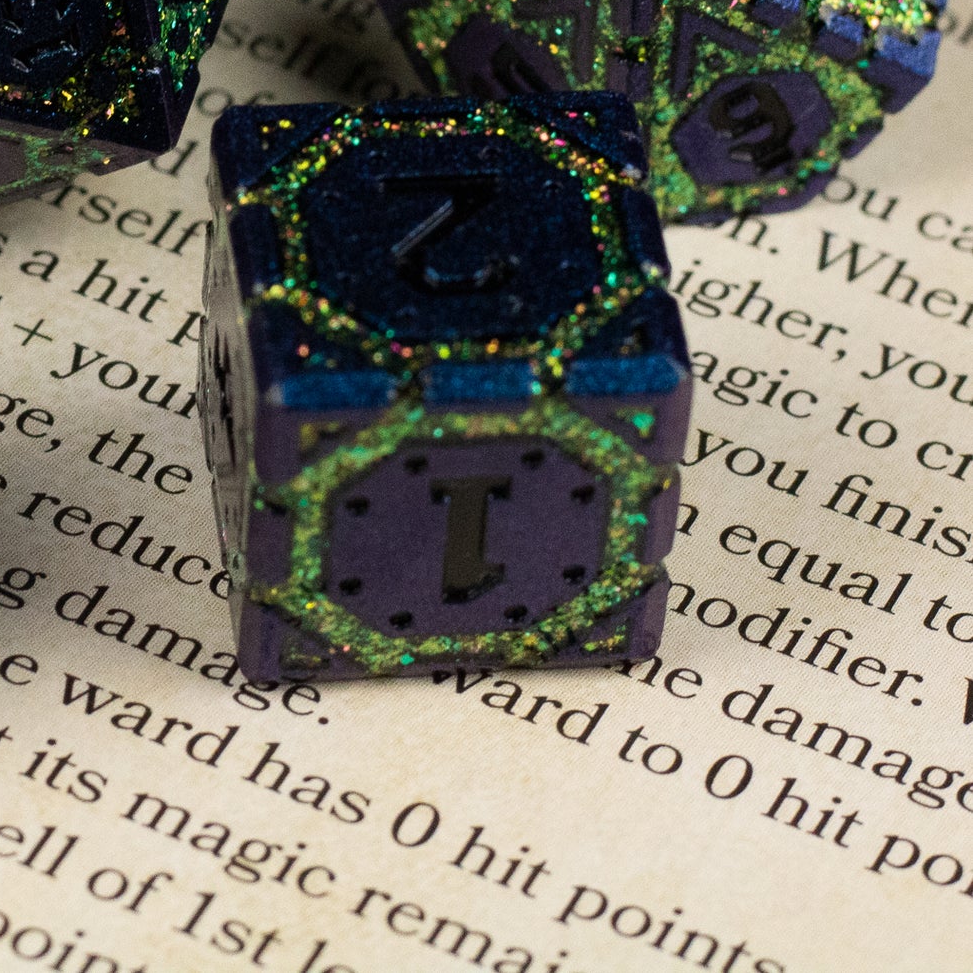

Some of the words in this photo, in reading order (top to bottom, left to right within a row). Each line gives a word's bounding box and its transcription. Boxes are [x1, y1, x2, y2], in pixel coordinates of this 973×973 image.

[19, 247, 61, 283] a
[71, 257, 168, 324] hit
[379, 171, 519, 295] 2
[12, 317, 55, 348] +
[88, 428, 194, 496] the
[834, 401, 899, 450] to
[429, 476, 513, 605] 1
[678, 427, 810, 498] you
[819, 473, 973, 564] finis
[718, 523, 914, 615] equal
[62, 671, 241, 769] ward
[242, 741, 371, 825] has
[390, 801, 441, 848] 0
[449, 825, 553, 900] hit
[431, 667, 610, 747] ward
[617, 724, 684, 776] to
[703, 753, 755, 800] 0
[760, 776, 864, 850] hit
[18, 737, 109, 804] its
[120, 792, 338, 900] magic
[86, 866, 176, 915] of
[175, 890, 282, 968] 1st
